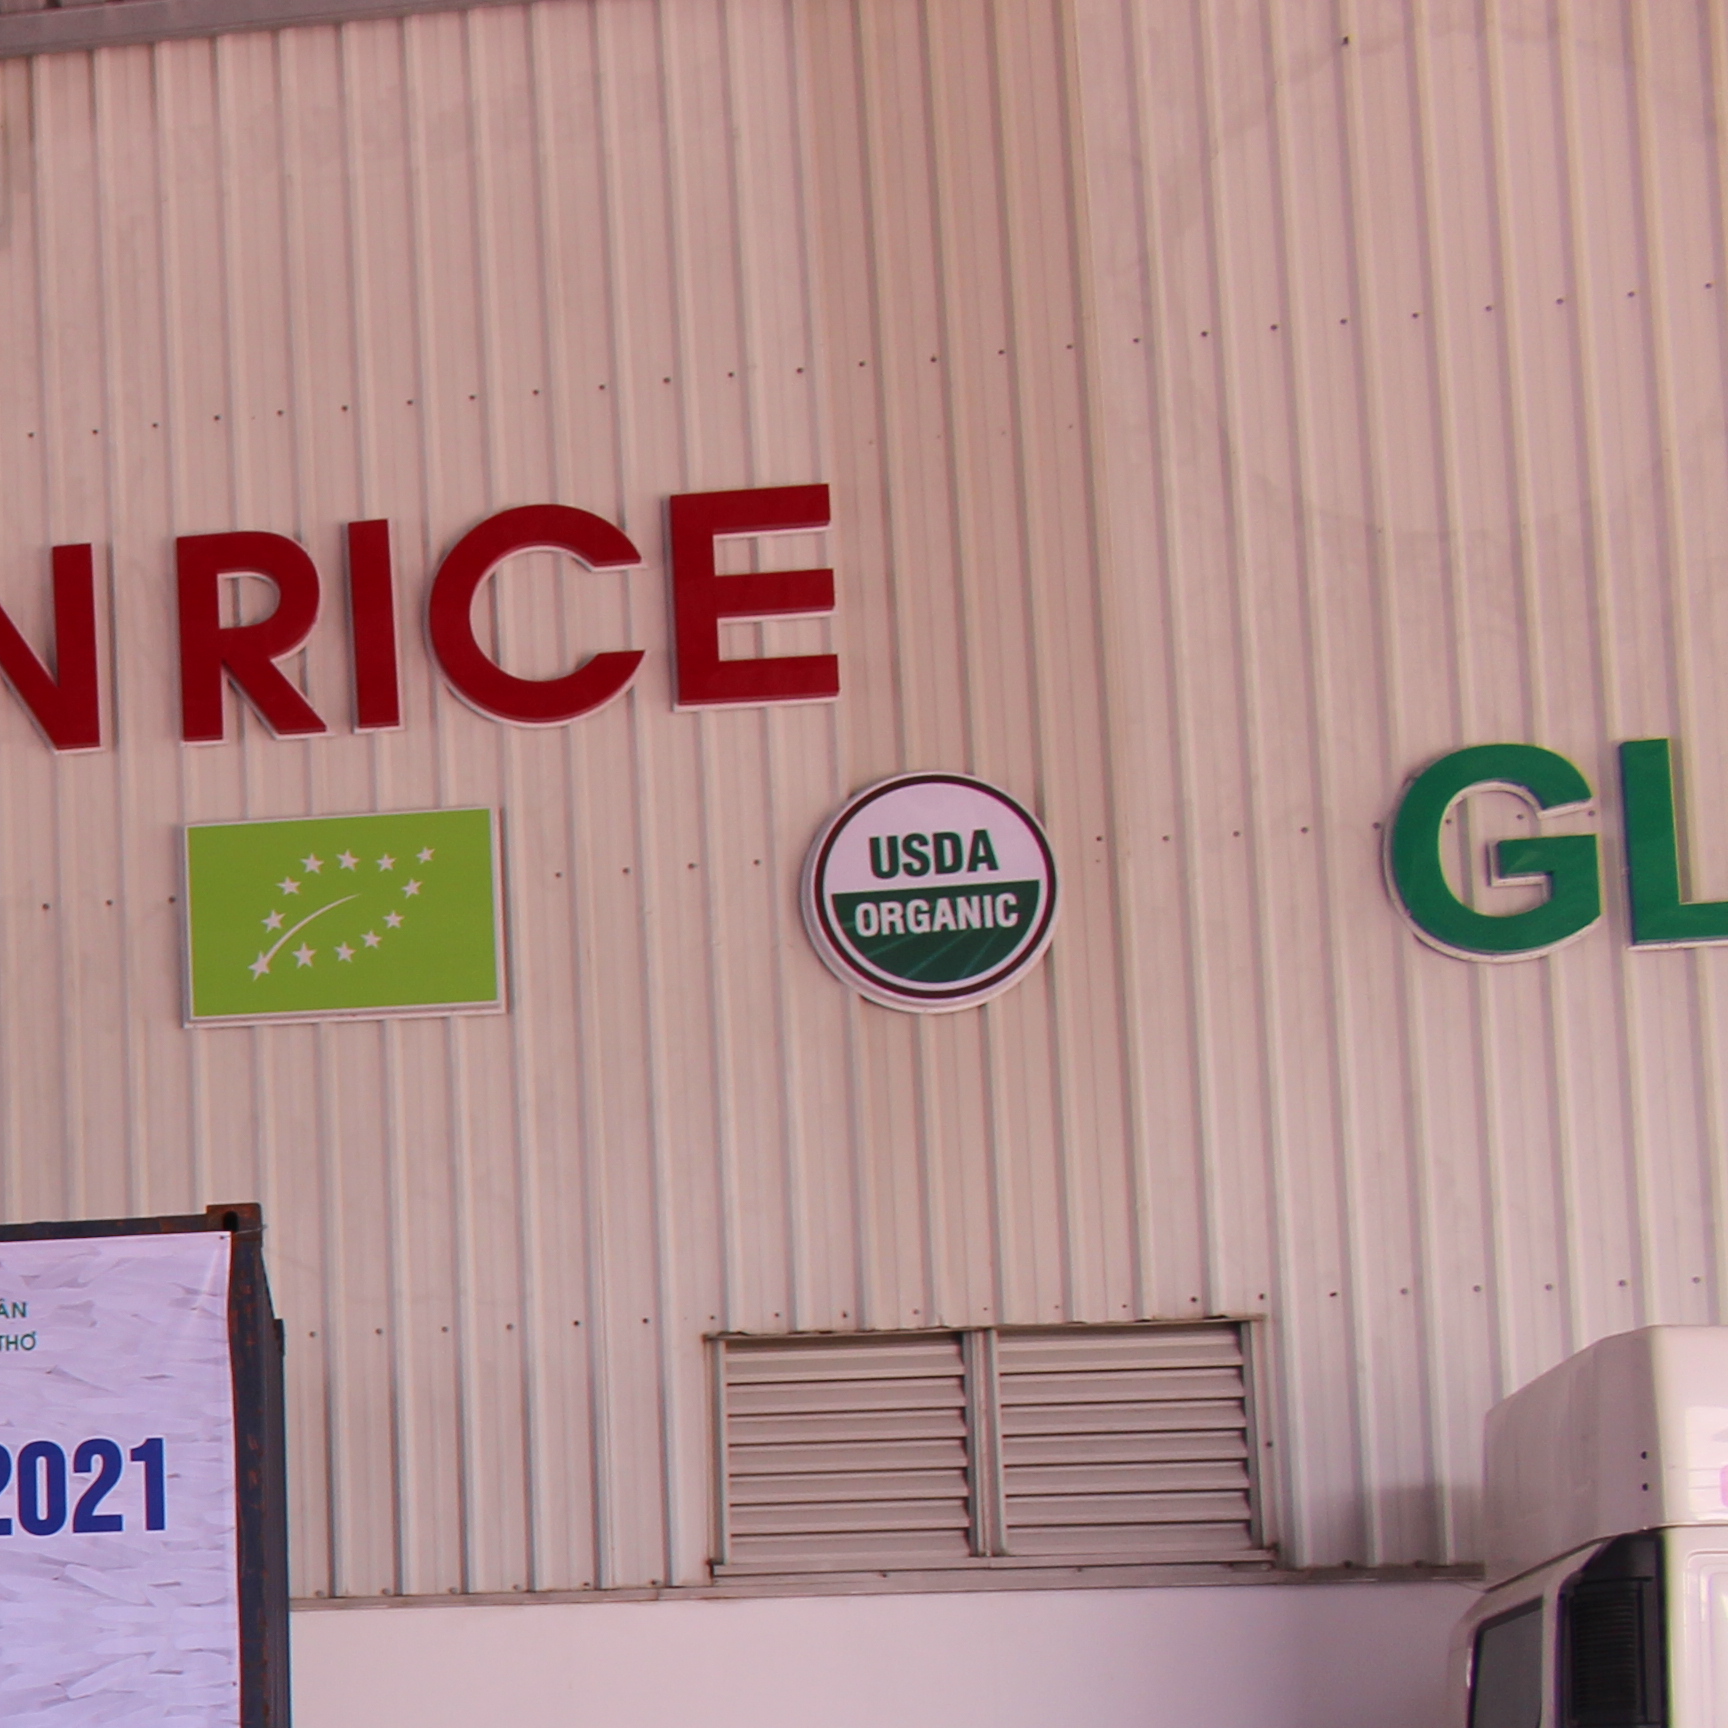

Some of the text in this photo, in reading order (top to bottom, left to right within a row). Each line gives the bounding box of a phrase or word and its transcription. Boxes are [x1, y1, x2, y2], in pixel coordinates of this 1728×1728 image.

[175, 483, 842, 745] RICE
[868, 828, 1000, 881] USDA
[1392, 738, 1728, 955] GL
[854, 892, 1020, 939] ORGANIC
